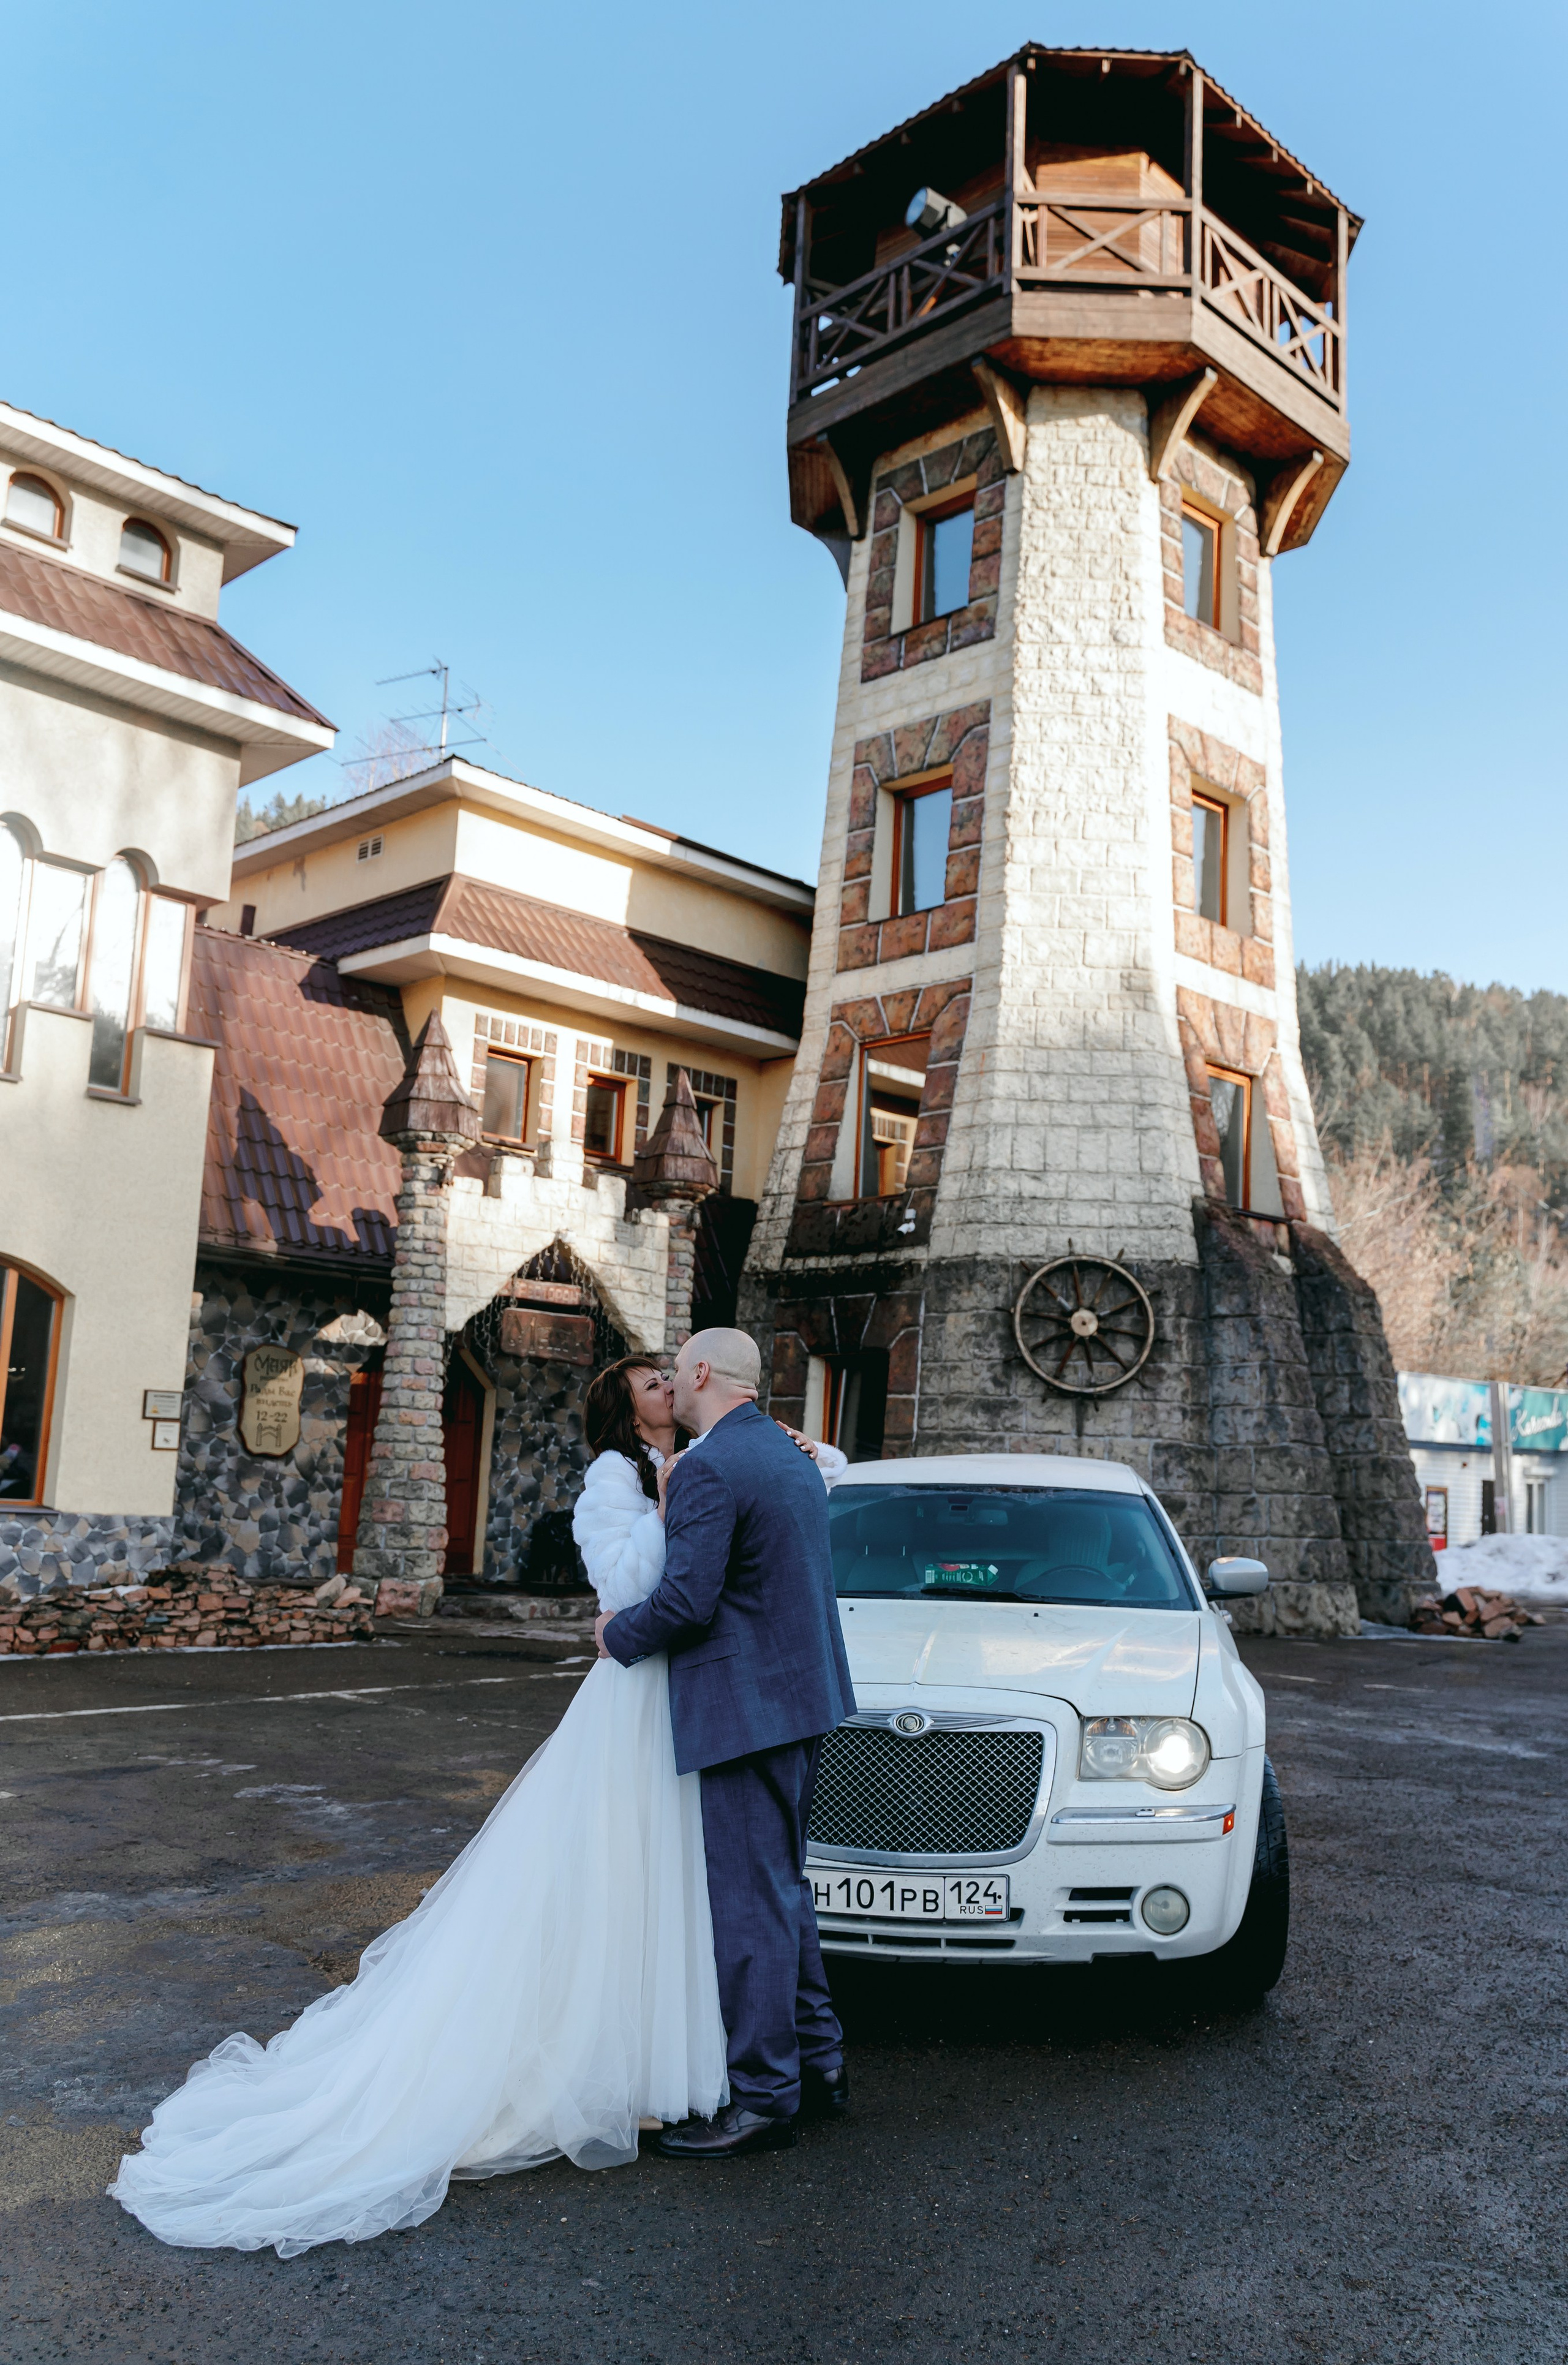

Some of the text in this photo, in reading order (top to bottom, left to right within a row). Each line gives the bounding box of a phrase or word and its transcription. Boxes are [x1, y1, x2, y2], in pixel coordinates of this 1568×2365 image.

[254, 1353, 298, 1378] Маяк
[257, 1410, 288, 1423] 12-22
[949, 1880, 998, 1904] 124
[959, 1905, 984, 1915] RUS
